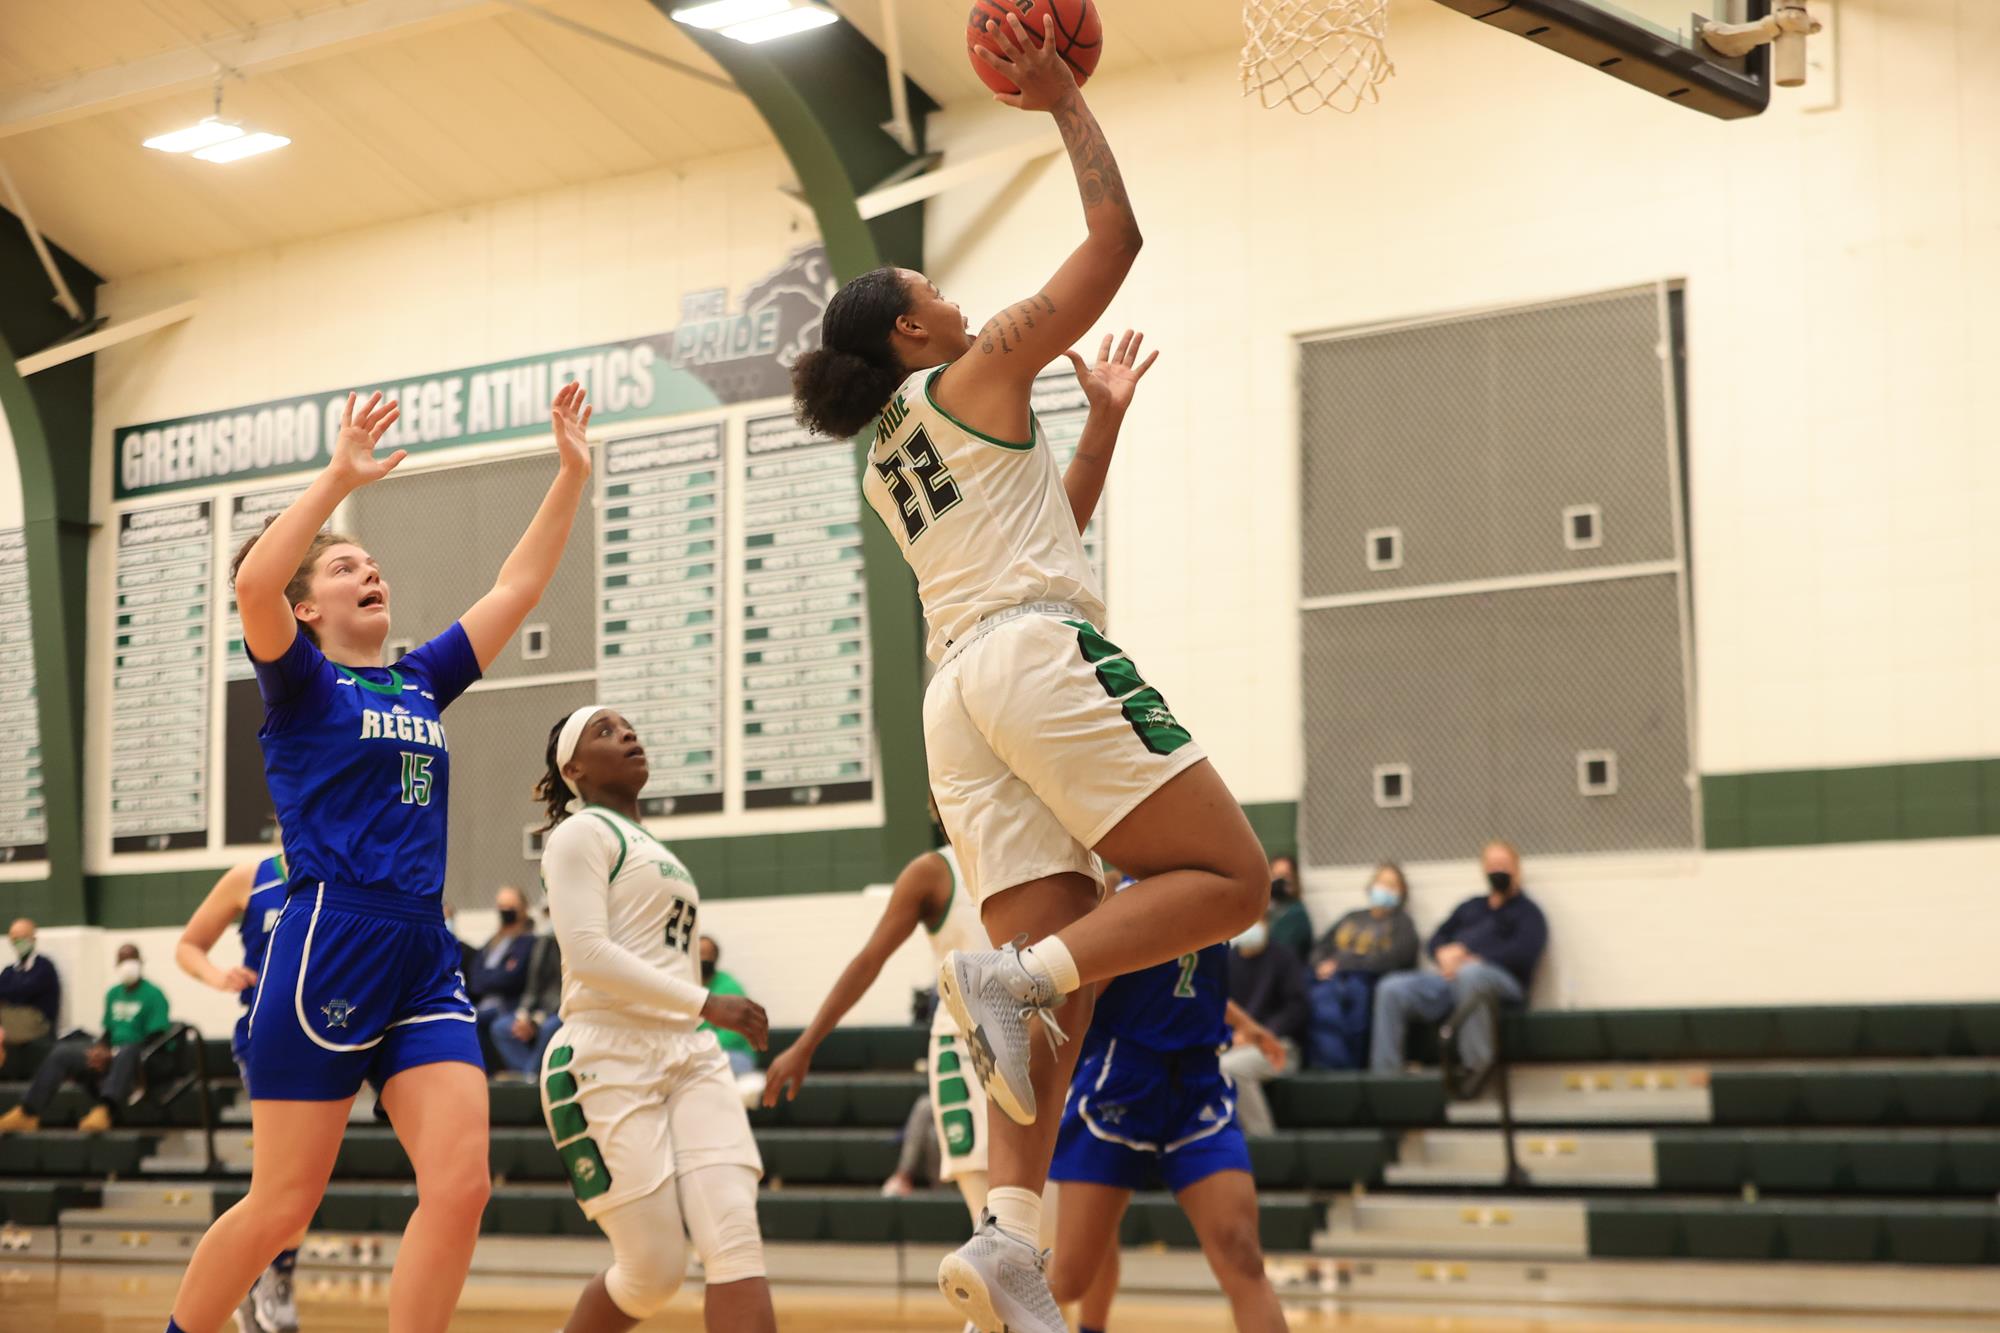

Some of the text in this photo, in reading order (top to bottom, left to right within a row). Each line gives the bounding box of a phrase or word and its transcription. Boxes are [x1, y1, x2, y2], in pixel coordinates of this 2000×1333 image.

[672, 306, 781, 370] PRIDE
[121, 401, 321, 491] GREENSBORO
[324, 376, 464, 457] CLEGE
[874, 393, 911, 453] RIDE
[872, 421, 964, 546] 22
[400, 751, 435, 807] 15
[1173, 951, 1199, 998] 2
